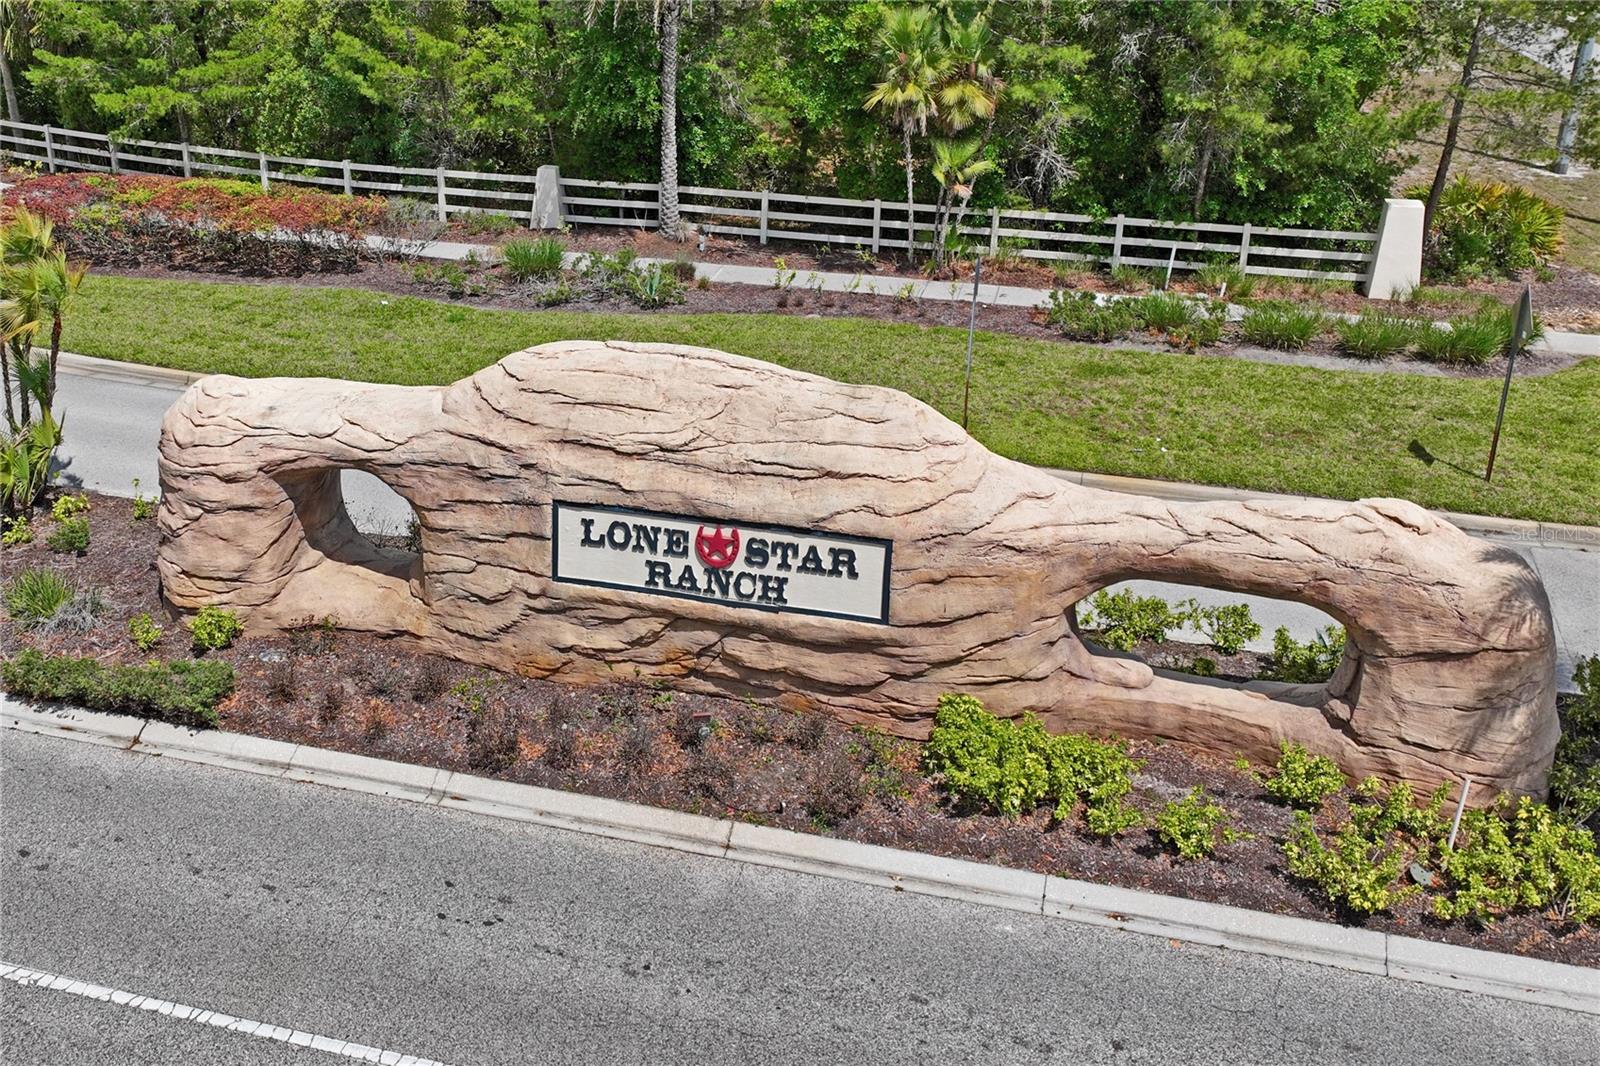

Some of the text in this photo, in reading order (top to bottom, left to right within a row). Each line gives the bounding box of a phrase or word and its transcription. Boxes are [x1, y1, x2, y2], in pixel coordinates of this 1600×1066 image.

[580, 518, 859, 579] LONE STAR
[645, 561, 788, 604] RANCH
